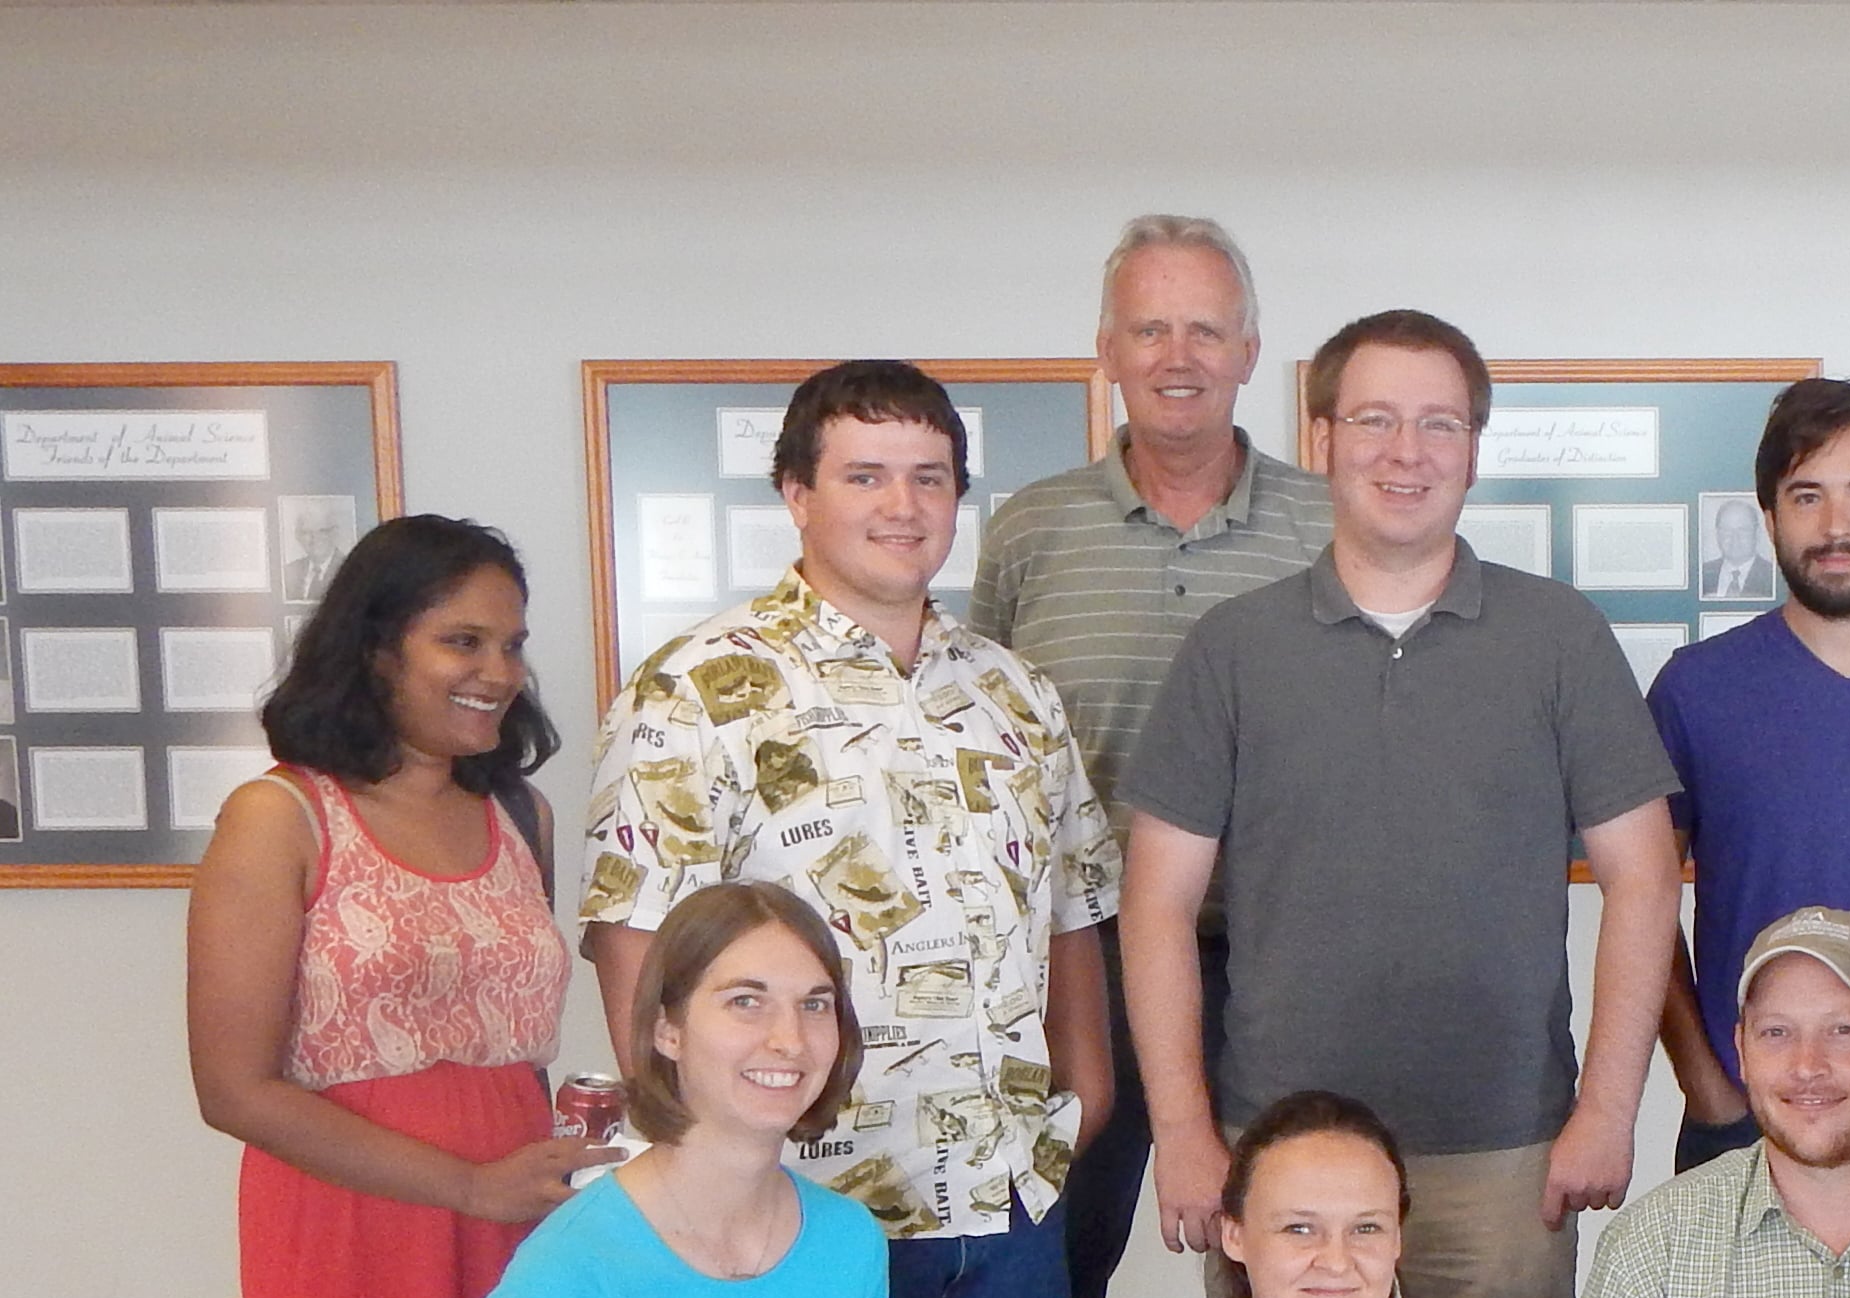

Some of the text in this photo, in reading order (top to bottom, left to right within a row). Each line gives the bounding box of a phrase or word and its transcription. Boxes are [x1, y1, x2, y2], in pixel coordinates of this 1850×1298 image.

[17, 423, 256, 448] Department of Animal Science
[1544, 421, 1557, 441] of
[1557, 421, 1604, 438] Animal
[1606, 421, 1648, 438] Science
[41, 443, 228, 469] Friends of the Department
[1552, 447, 1566, 467] of
[780, 818, 834, 848] LURES
[903, 819, 932, 908] LIVE BAIT
[1084, 887, 1104, 922] LIVE
[891, 935, 955, 955] ANGLERS
[799, 1140, 854, 1160] LURES
[934, 1137, 952, 1227] LIVE BAIT
